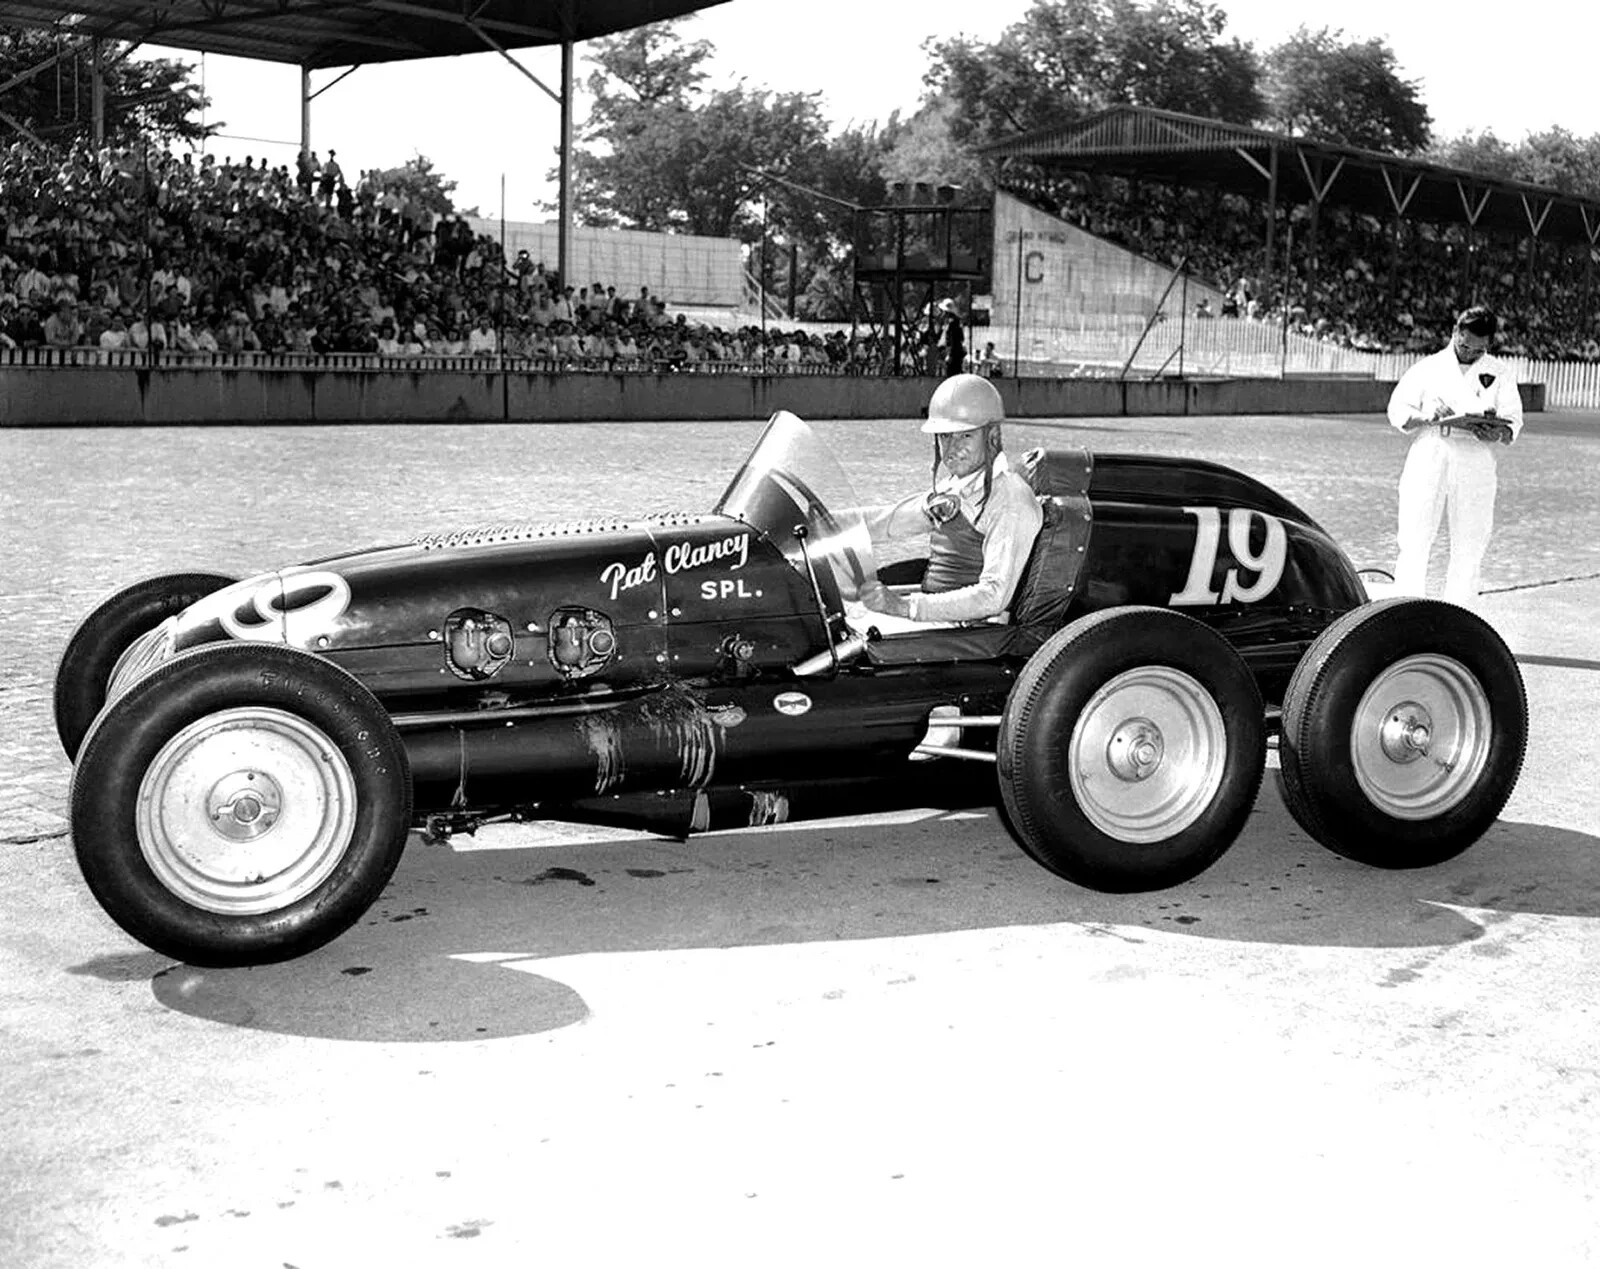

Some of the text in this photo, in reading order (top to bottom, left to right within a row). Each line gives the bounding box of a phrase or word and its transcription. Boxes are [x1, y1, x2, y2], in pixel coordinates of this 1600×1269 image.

[1025, 251, 1045, 284] C
[600, 533, 749, 601] Pat Clancy
[1168, 506, 1287, 606] 19
[701, 579, 763, 600] SPL.
